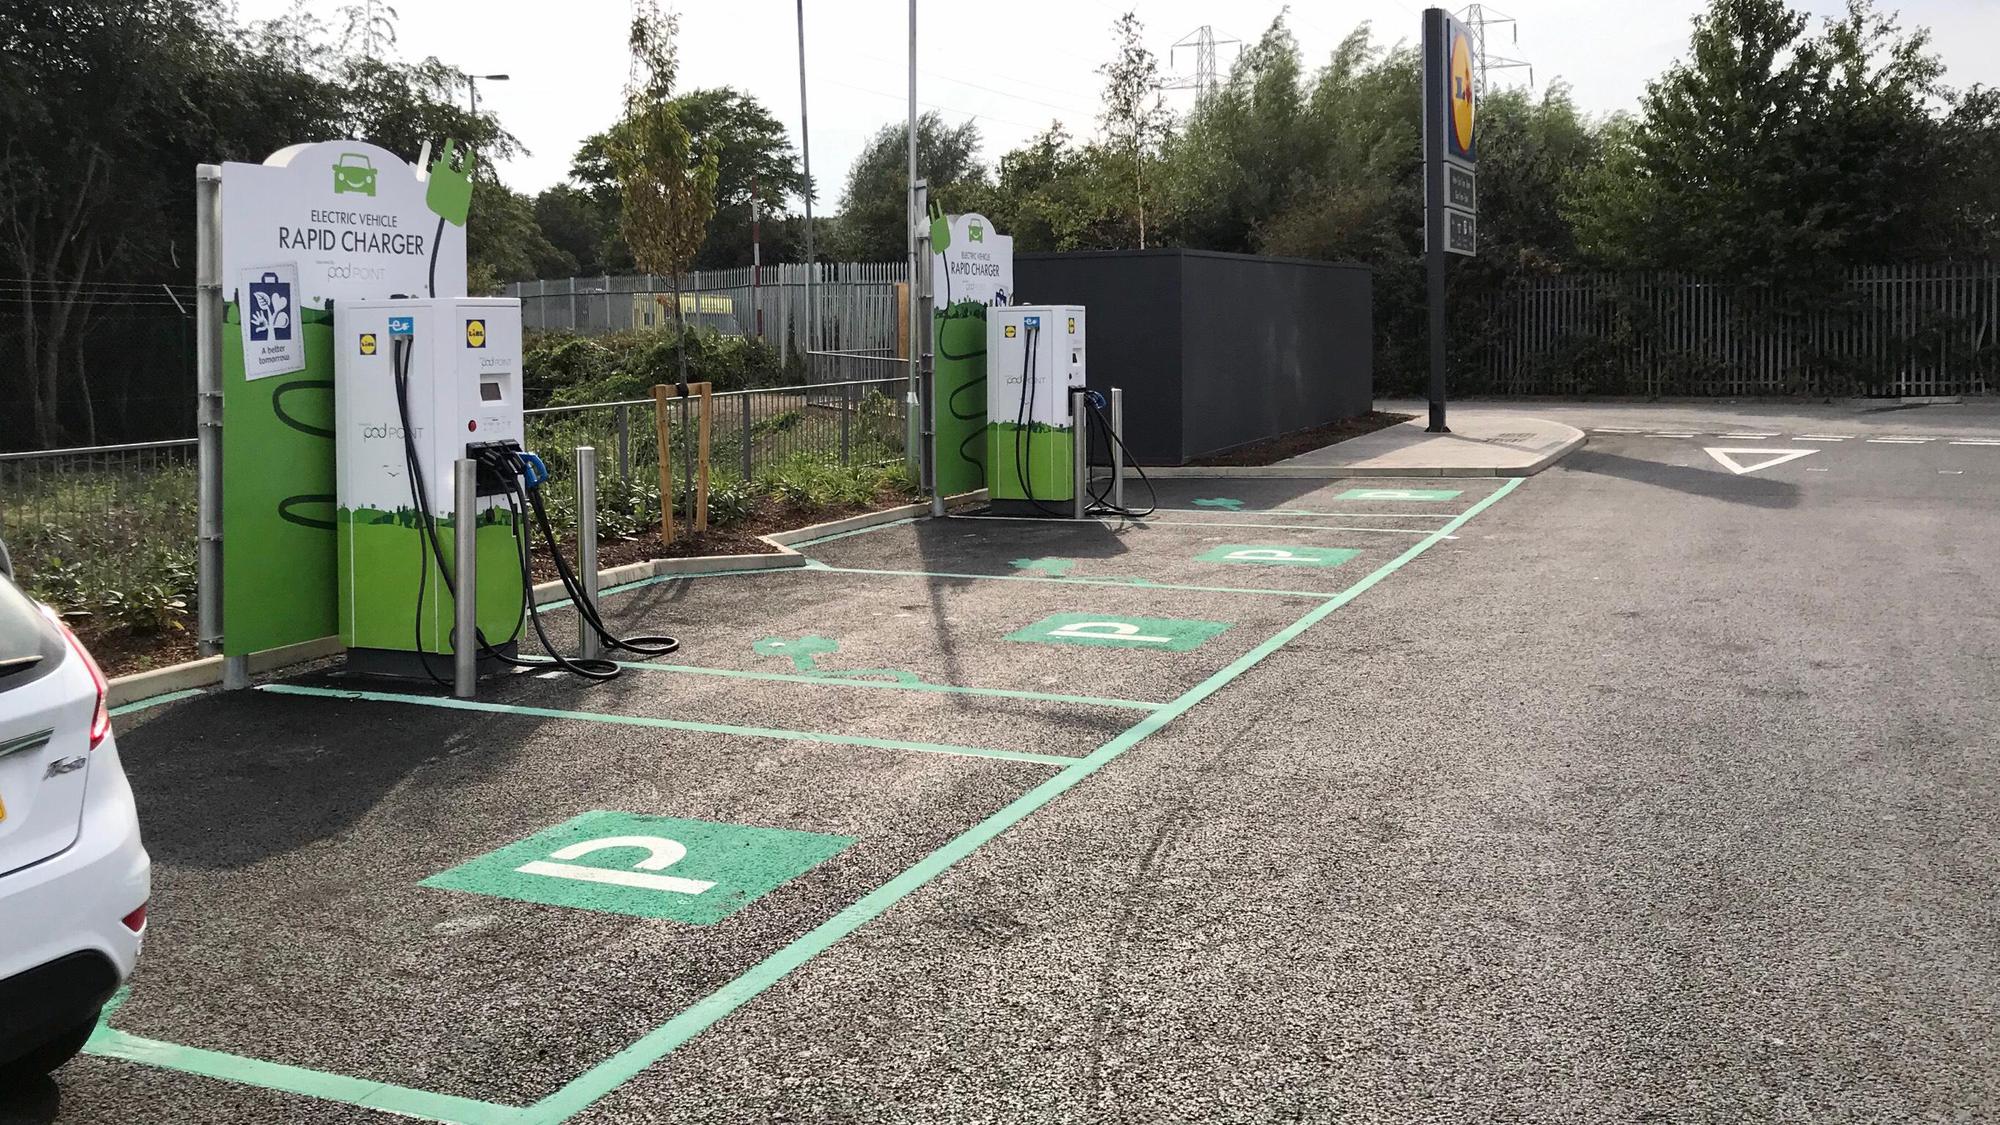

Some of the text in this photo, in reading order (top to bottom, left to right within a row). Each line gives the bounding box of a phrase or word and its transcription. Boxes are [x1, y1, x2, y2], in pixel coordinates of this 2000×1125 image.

[311, 209, 398, 228] ELECTRIC VEHICLE
[279, 226, 425, 256] RAPID CHARGER
[328, 262, 386, 282] pod POINT
[951, 261, 1000, 277] RAPID CHARGER
[267, 345, 286, 354] better
[258, 355, 290, 365] tomorrow
[363, 422, 425, 444] pod PONT
[514, 835, 718, 895] P
